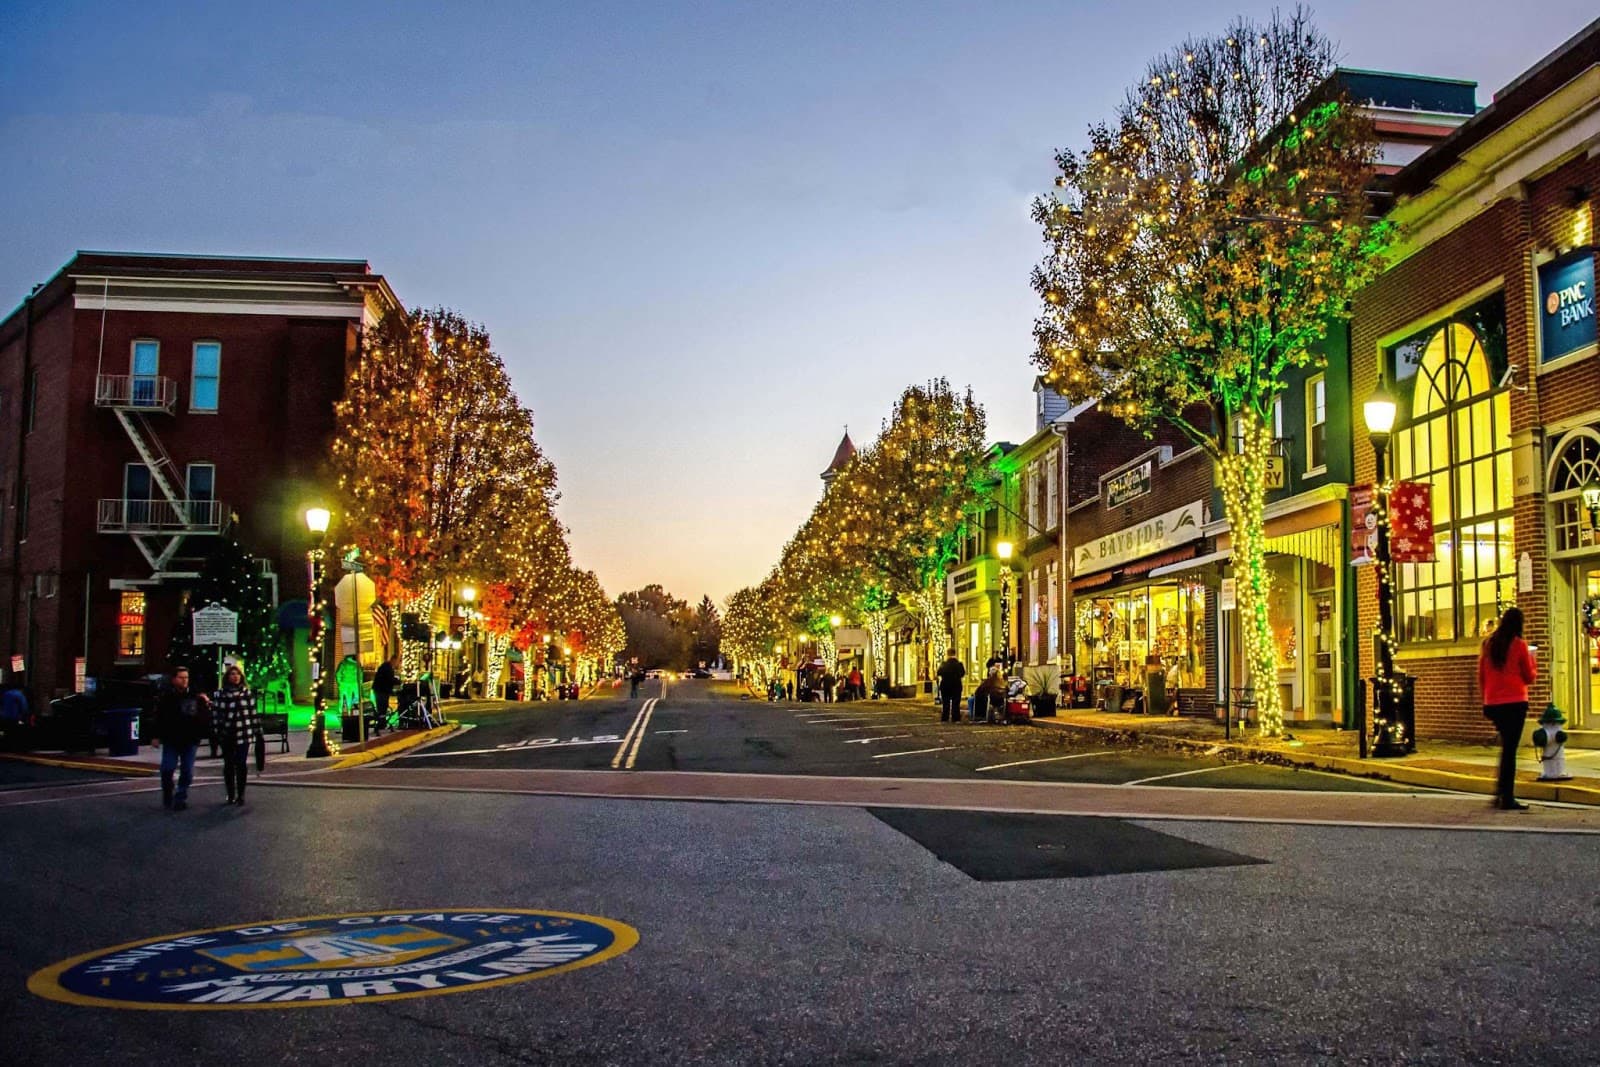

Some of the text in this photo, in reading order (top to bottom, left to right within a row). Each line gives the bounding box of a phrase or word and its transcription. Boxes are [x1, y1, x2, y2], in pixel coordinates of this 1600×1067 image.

[1559, 281, 1586, 308] PNC
[1560, 298, 1594, 327] BANK
[1099, 520, 1164, 558] BAYSIDE
[84, 913, 521, 973] HAVRE DE GRACE
[188, 943, 598, 1002] MARYLAND
